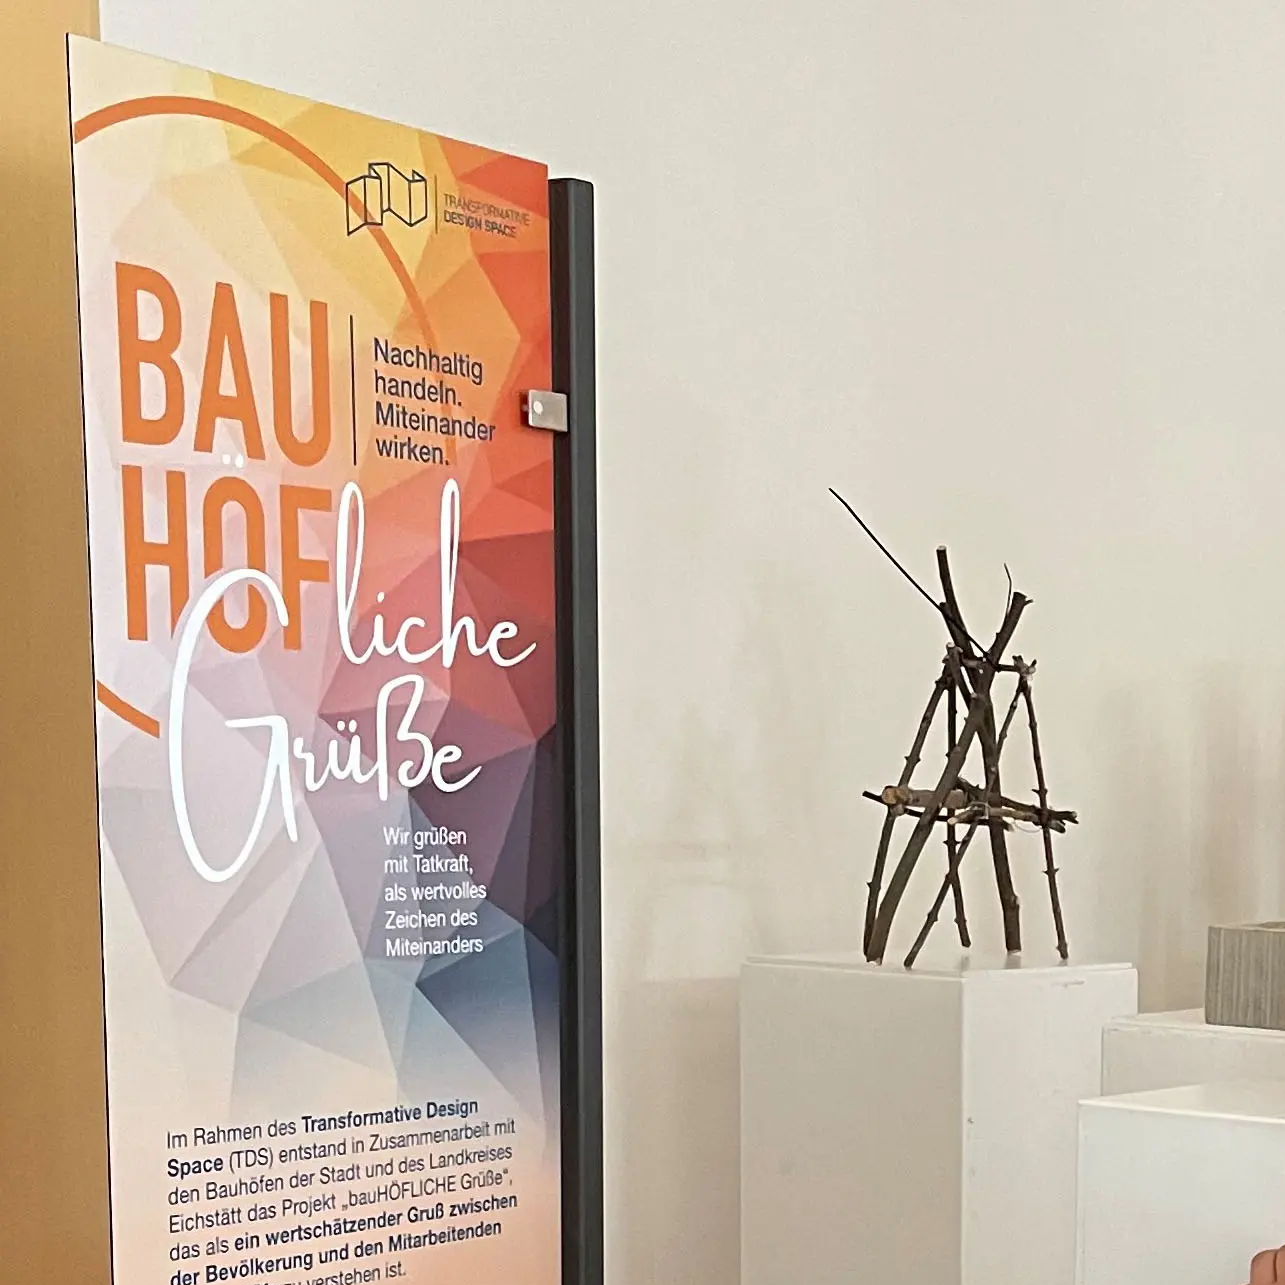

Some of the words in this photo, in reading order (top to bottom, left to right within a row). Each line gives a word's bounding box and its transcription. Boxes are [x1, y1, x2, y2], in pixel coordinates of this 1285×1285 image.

[444, 211, 482, 231] DESIGN
[485, 220, 517, 238] SPACE
[116, 261, 331, 467] BAU
[374, 337, 483, 385] Nachhaltig
[374, 369, 462, 407] handeln.
[376, 400, 496, 441] Miteinander
[376, 434, 449, 465] wirken.
[168, 568, 482, 882] Grüße
[383, 826, 410, 845] Wir
[414, 826, 467, 850] grüßen
[384, 855, 409, 873] mit
[413, 853, 473, 875] Tatkraft,
[384, 883, 407, 901] als
[411, 881, 487, 901] wertvolles
[385, 908, 447, 930] Zeichen
[450, 908, 478, 927] des
[386, 935, 484, 957] Miteinanders
[167, 1131, 187, 1148] Im
[193, 1125, 262, 1146] Rahmen
[267, 1119, 296, 1137] des
[302, 1105, 421, 1132] Transformative
[426, 1099, 478, 1118] Design
[167, 1157, 223, 1179] Space
[229, 1147, 273, 1173] (TDS)
[278, 1138, 346, 1163] entstand
[351, 1137, 364, 1153] in
[369, 1122, 489, 1151] Zusammenarbeit
[494, 1118, 514, 1135] mit
[167, 1186, 199, 1205] den
[205, 1174, 283, 1200] Bauhöfen
[289, 1171, 315, 1188] der
[319, 1163, 360, 1184] Stadt
[365, 1157, 393, 1178] und
[398, 1156, 424, 1173] des
[429, 1146, 512, 1169] Landkreises
[169, 1207, 241, 1233] Eichstätt
[247, 1203, 276, 1221] das
[282, 1193, 335, 1217] Projekt
[169, 1243, 200, 1261] das
[205, 1236, 229, 1255] als
[234, 1231, 259, 1250] ein
[265, 1211, 402, 1245] wertschätzender
[407, 1202, 444, 1223] Gruß
[449, 1194, 517, 1216] zwischen
[205, 1253, 312, 1283] Bevölkerung
[318, 1243, 348, 1263] und
[354, 1240, 383, 1257] den
[388, 1221, 501, 1251] Mitarbeitenden
[385, 1260, 406, 1278] ist.
